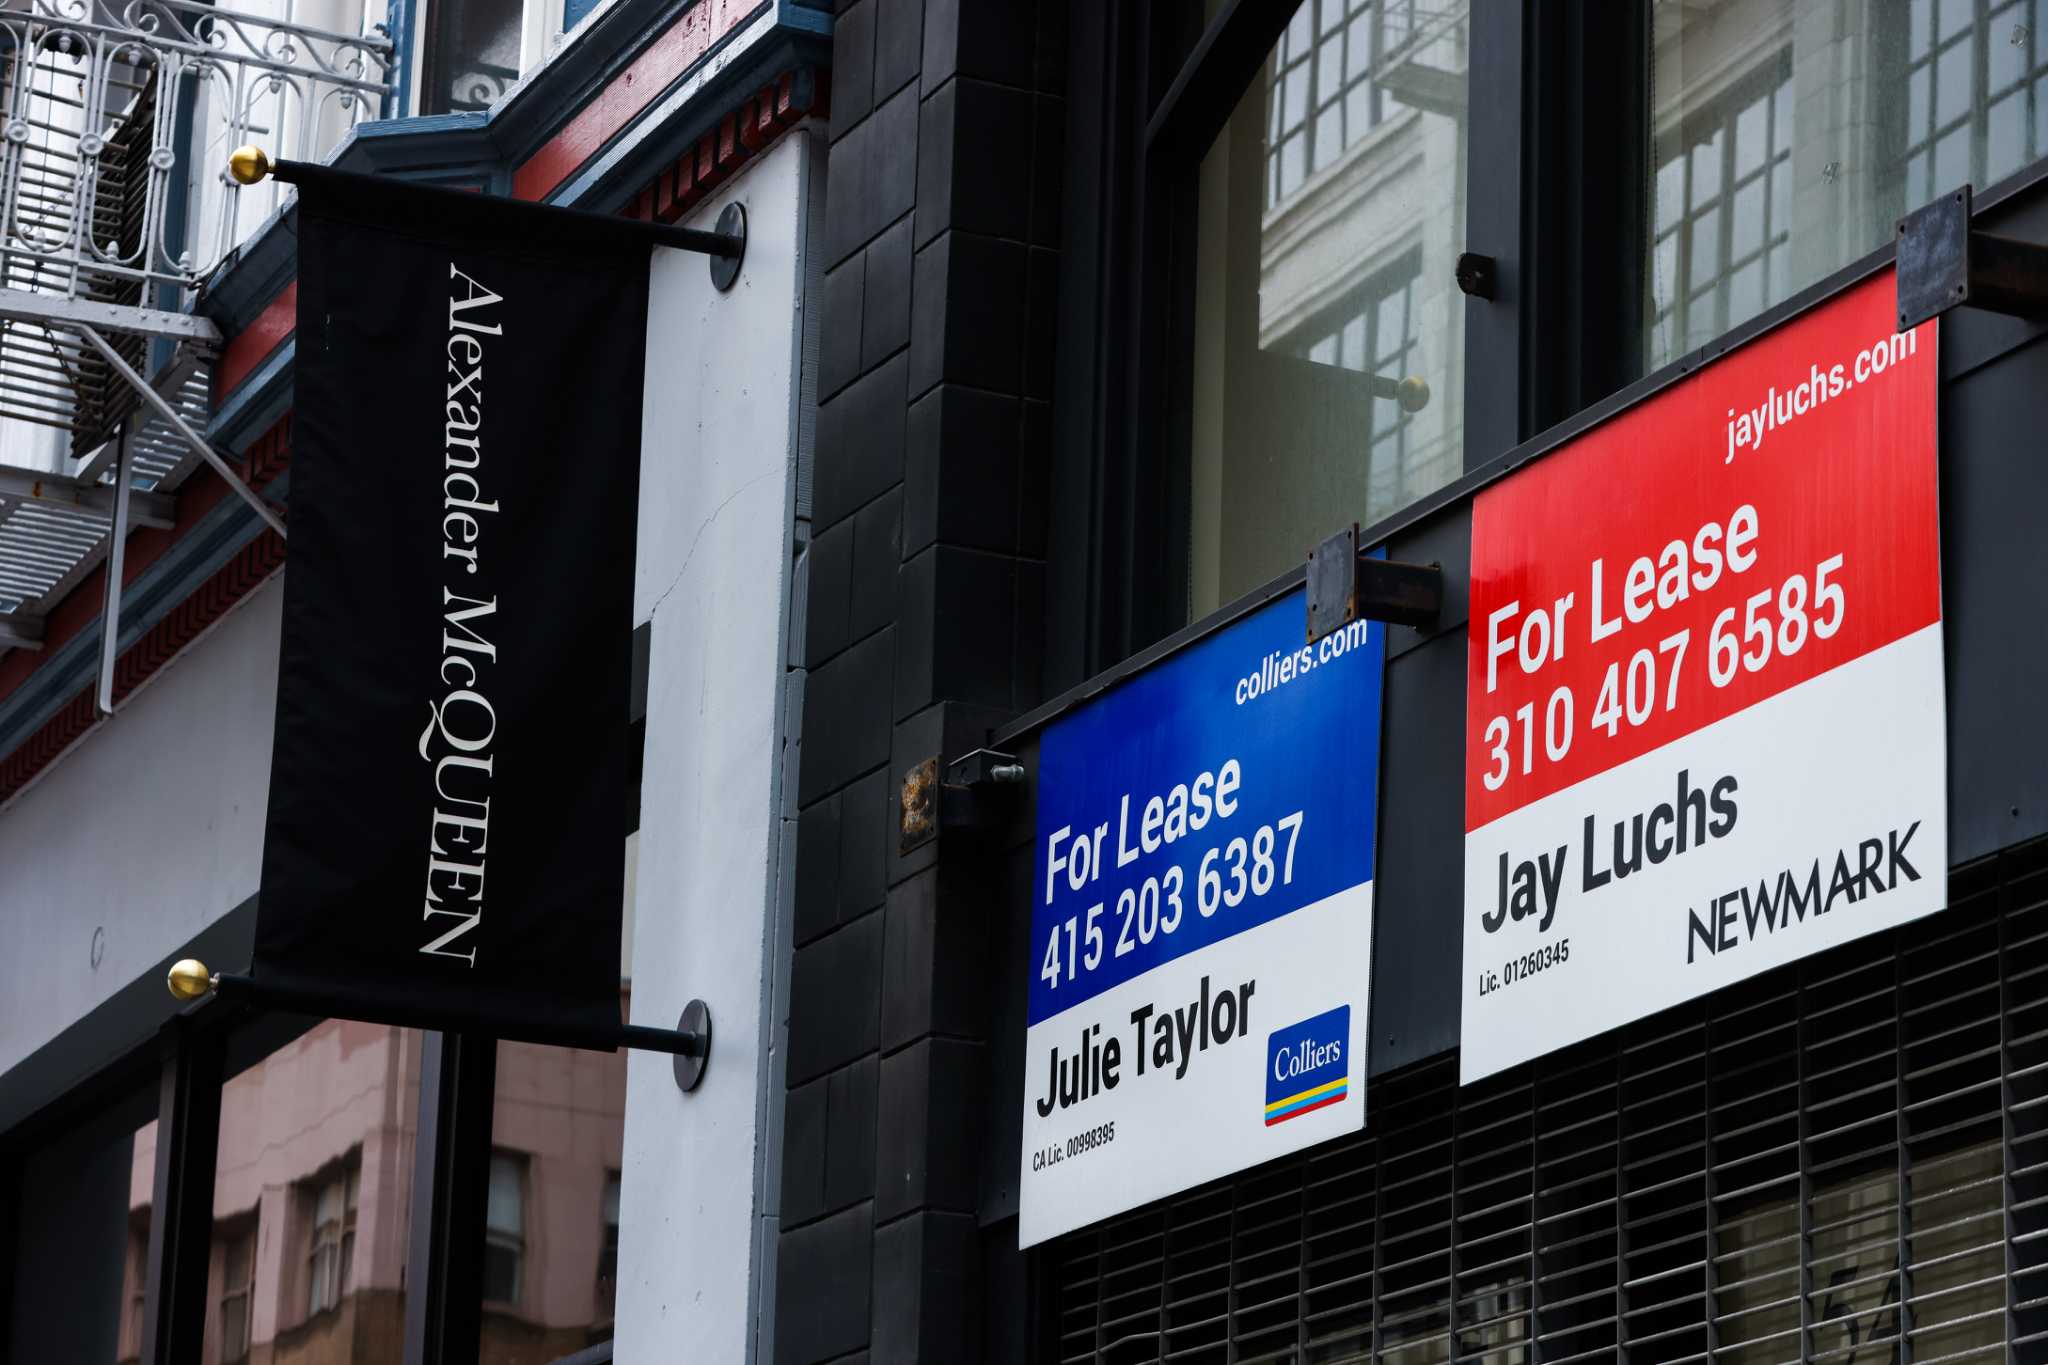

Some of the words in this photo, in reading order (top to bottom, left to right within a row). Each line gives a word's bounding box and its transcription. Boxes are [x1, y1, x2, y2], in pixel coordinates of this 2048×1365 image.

[441, 262, 504, 574] Alexander
[1725, 327, 1917, 465] jayluchs.com
[1235, 618, 1368, 706] colliers.com
[1486, 591, 1575, 694] For
[1591, 504, 1759, 644] Lease
[1483, 685, 1574, 792] 310
[1591, 627, 1690, 738] 407
[1708, 553, 1845, 689] 6585
[418, 585, 497, 970] McQUEEN
[1046, 820, 1109, 905] For
[1117, 758, 1241, 869] Lease
[1041, 889, 1104, 989] 415
[1114, 865, 1184, 958] 203
[1197, 810, 1304, 918] 6387
[1481, 844, 1568, 934] Jay
[1582, 768, 1738, 894] Luchs
[1688, 820, 1922, 965] NEWMARK
[1479, 969, 1501, 997] Lic.
[1504, 938, 1569, 986] 01260345
[1036, 1023, 1121, 1118] Julie
[1130, 975, 1256, 1081] Taylor
[1274, 1037, 1341, 1083] Colliers
[1032, 1149, 1046, 1172] CA
[1047, 1143, 1064, 1167] Lic.
[1066, 1120, 1115, 1158] 00998395
